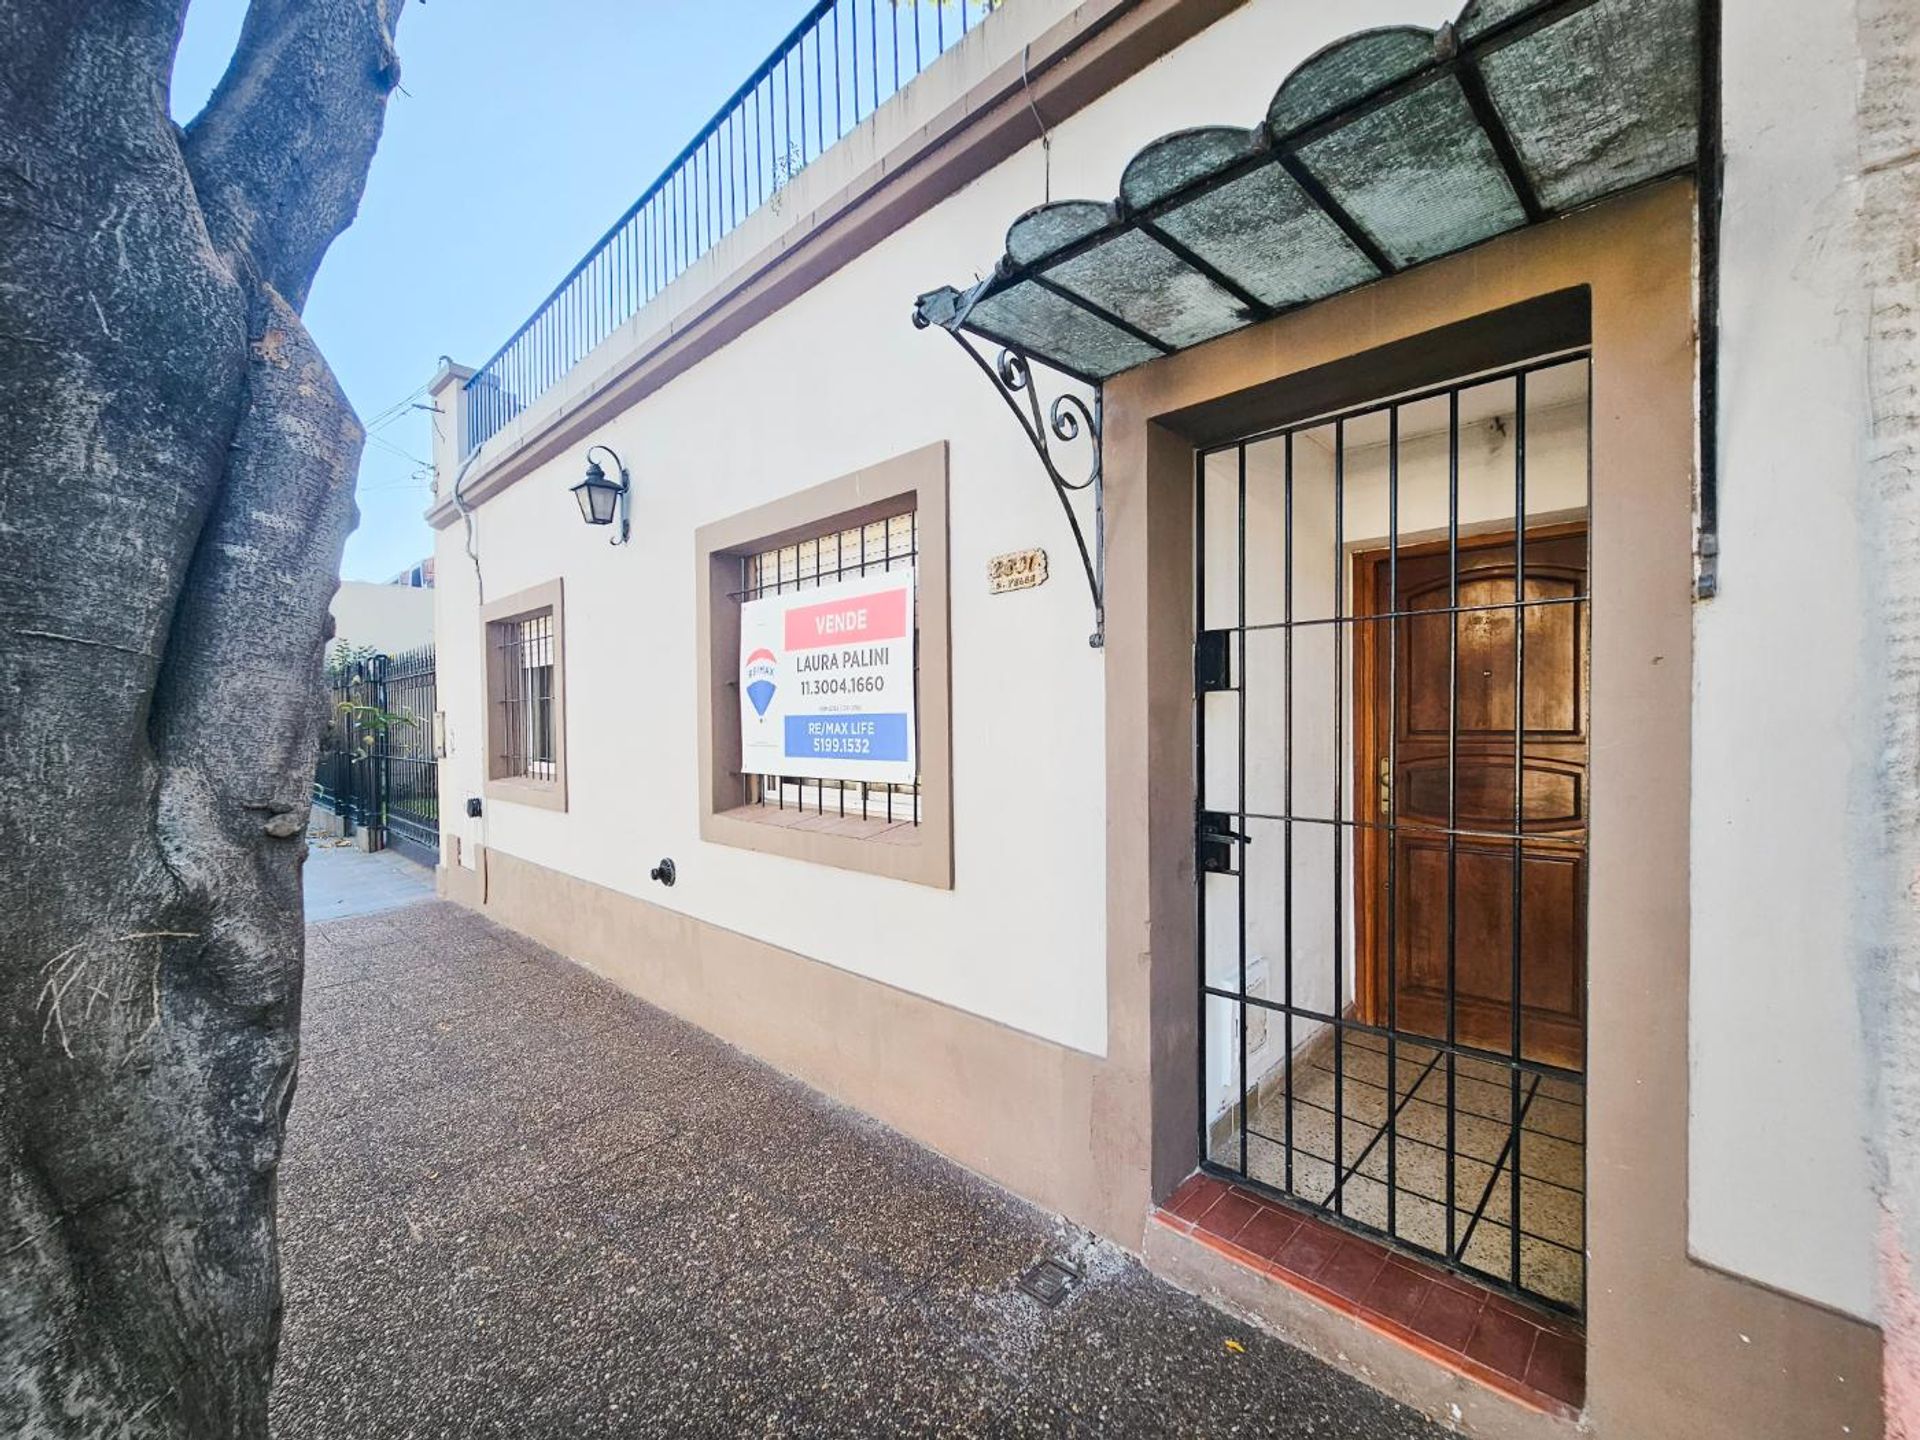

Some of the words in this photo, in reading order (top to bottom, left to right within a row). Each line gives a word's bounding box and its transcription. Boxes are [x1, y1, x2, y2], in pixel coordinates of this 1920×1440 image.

[815, 608, 867, 635] VENDE
[796, 653, 839, 673] LAURA
[843, 647, 889, 669] PALINI
[801, 675, 884, 696] 11.3004.1660
[807, 721, 848, 736] RE/MAX
[851, 721, 875, 735] LIFE
[813, 737, 870, 753] 5199.1532
